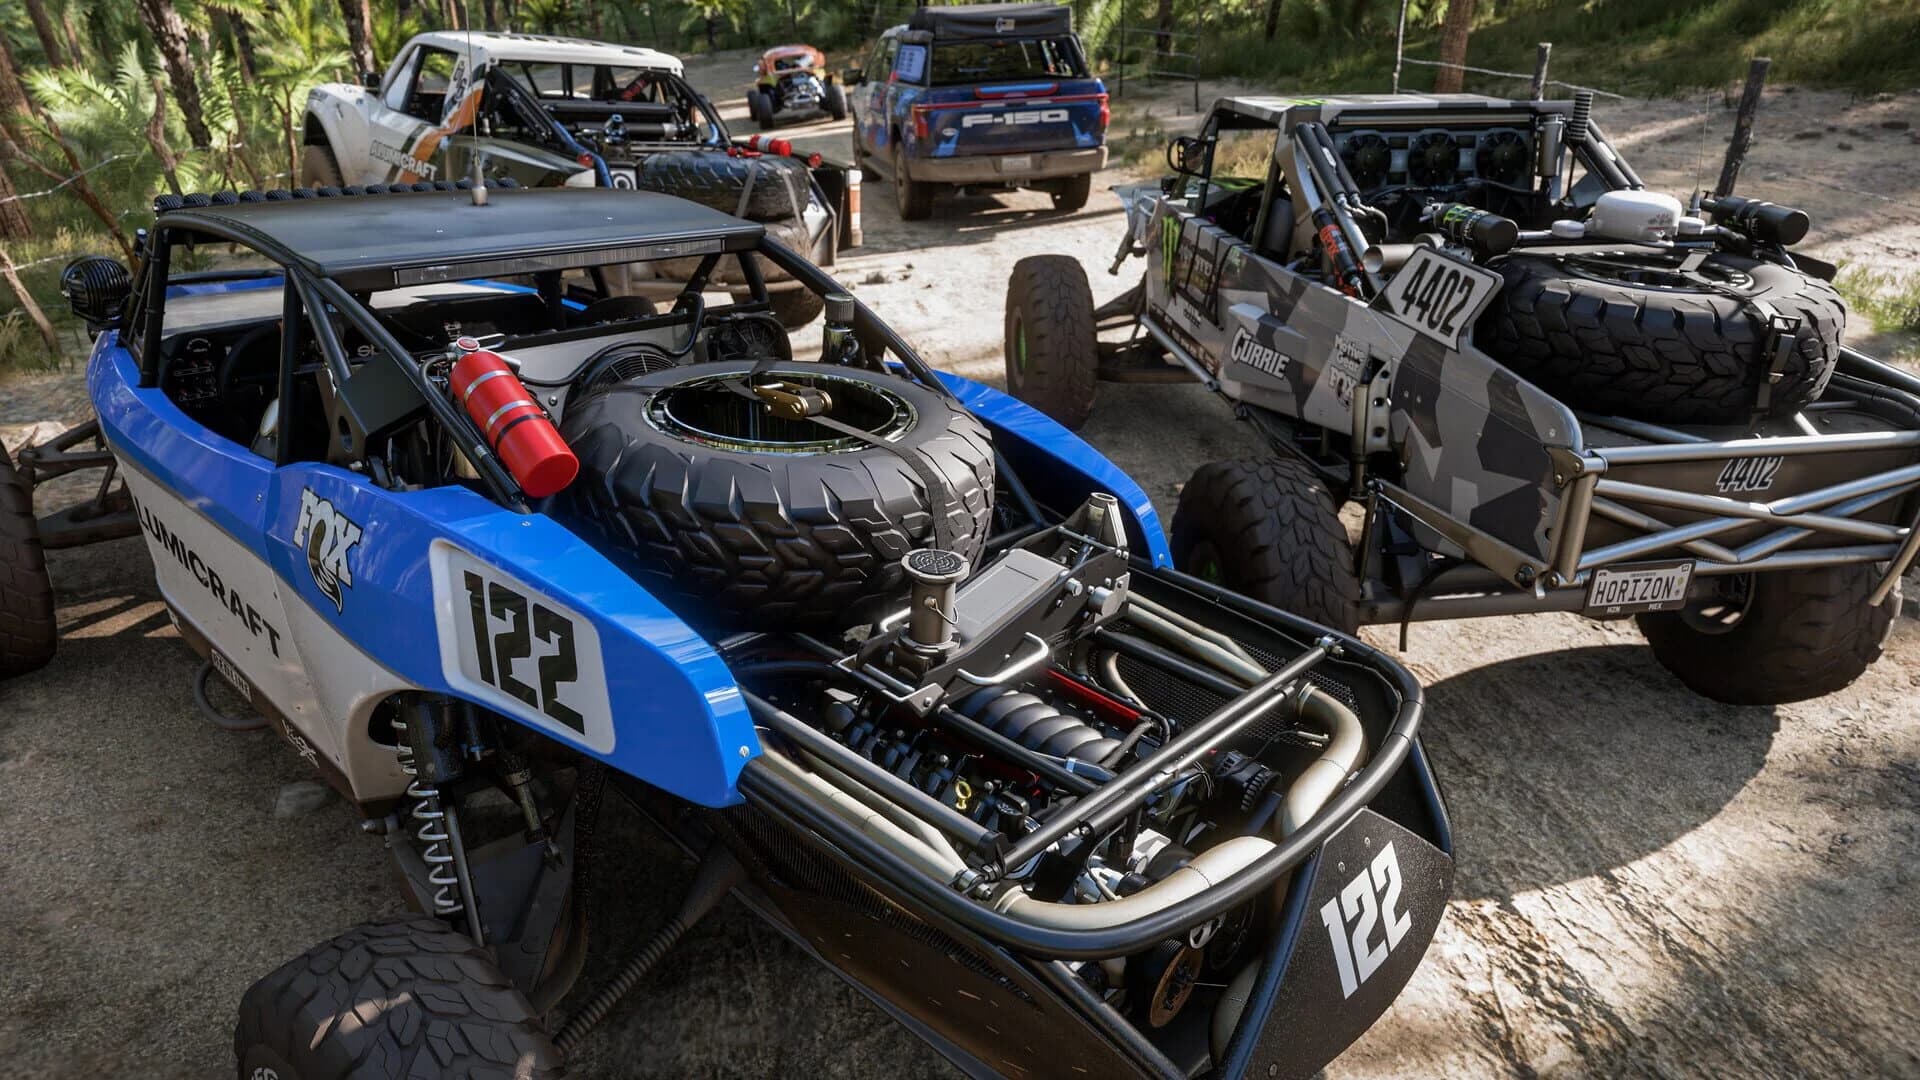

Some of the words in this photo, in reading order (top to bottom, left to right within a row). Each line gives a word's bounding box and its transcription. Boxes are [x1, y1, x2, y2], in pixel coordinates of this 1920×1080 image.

[962, 109, 1069, 128] F-150
[1401, 258, 1475, 337] 4402
[1231, 326, 1291, 379] CURRIE
[1716, 456, 1784, 492] 4402
[293, 486, 364, 606] FOX
[1593, 576, 1676, 605] HORIZON
[464, 570, 585, 736] 122
[1320, 840, 1412, 1000] 122
